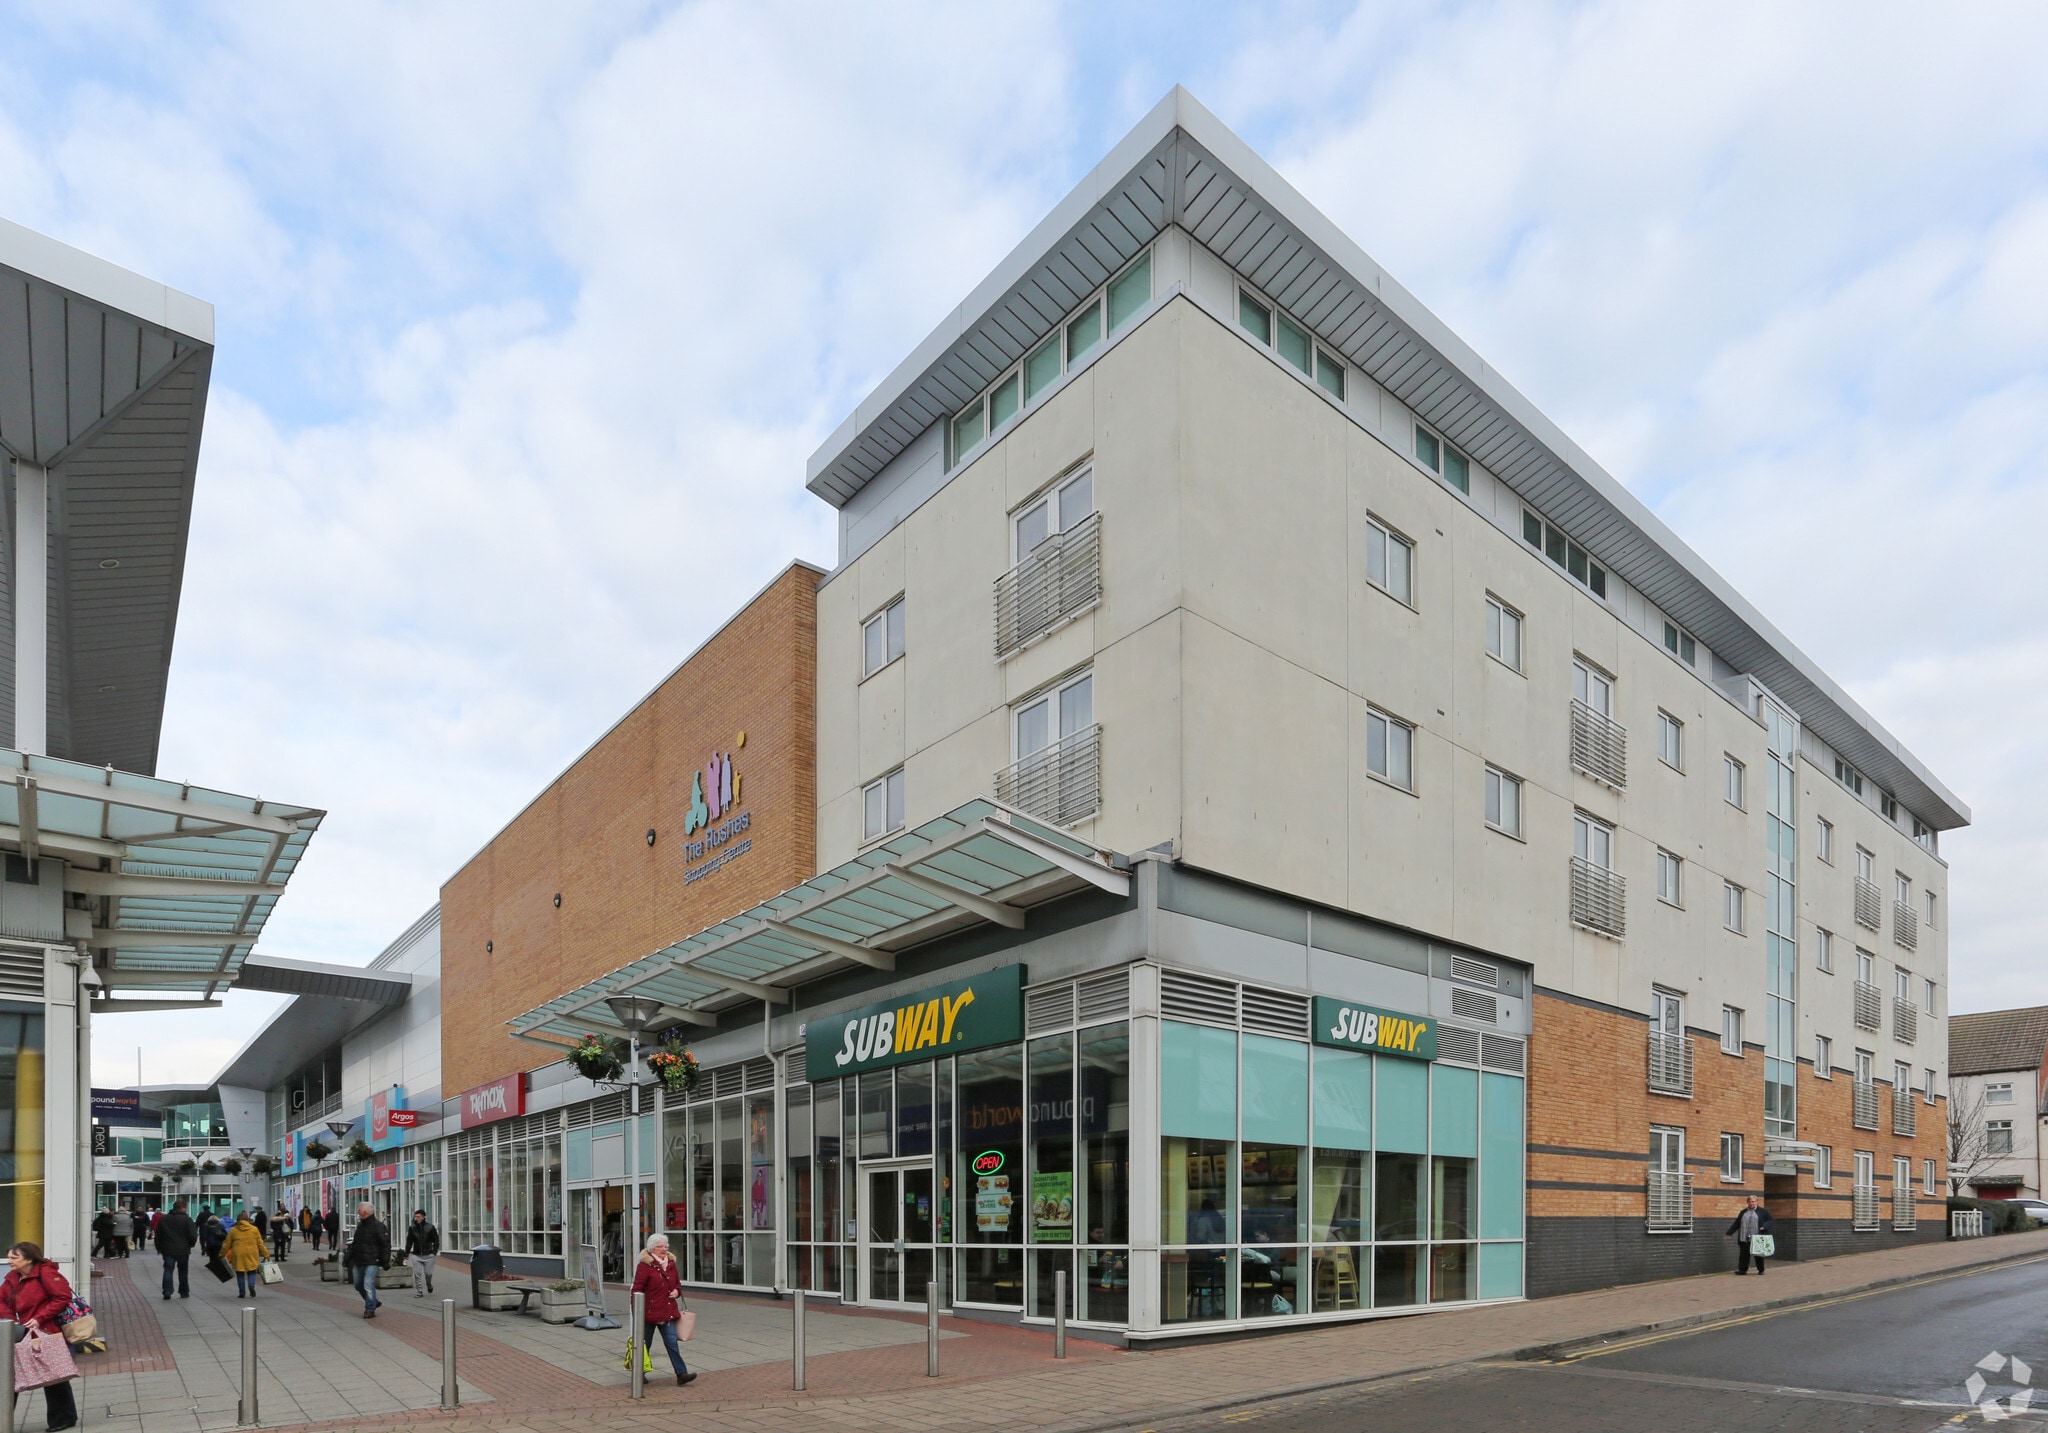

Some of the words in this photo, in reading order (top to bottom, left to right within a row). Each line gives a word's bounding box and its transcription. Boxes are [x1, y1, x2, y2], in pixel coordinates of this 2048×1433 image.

[682, 841, 704, 863] The
[705, 810, 751, 852] Rushes
[834, 985, 976, 1068] SUBWAY
[1330, 1007, 1427, 1052] SUBWAY
[392, 1112, 414, 1122] Argos
[95, 1126, 106, 1153] next
[976, 1156, 1000, 1170] OPEN
